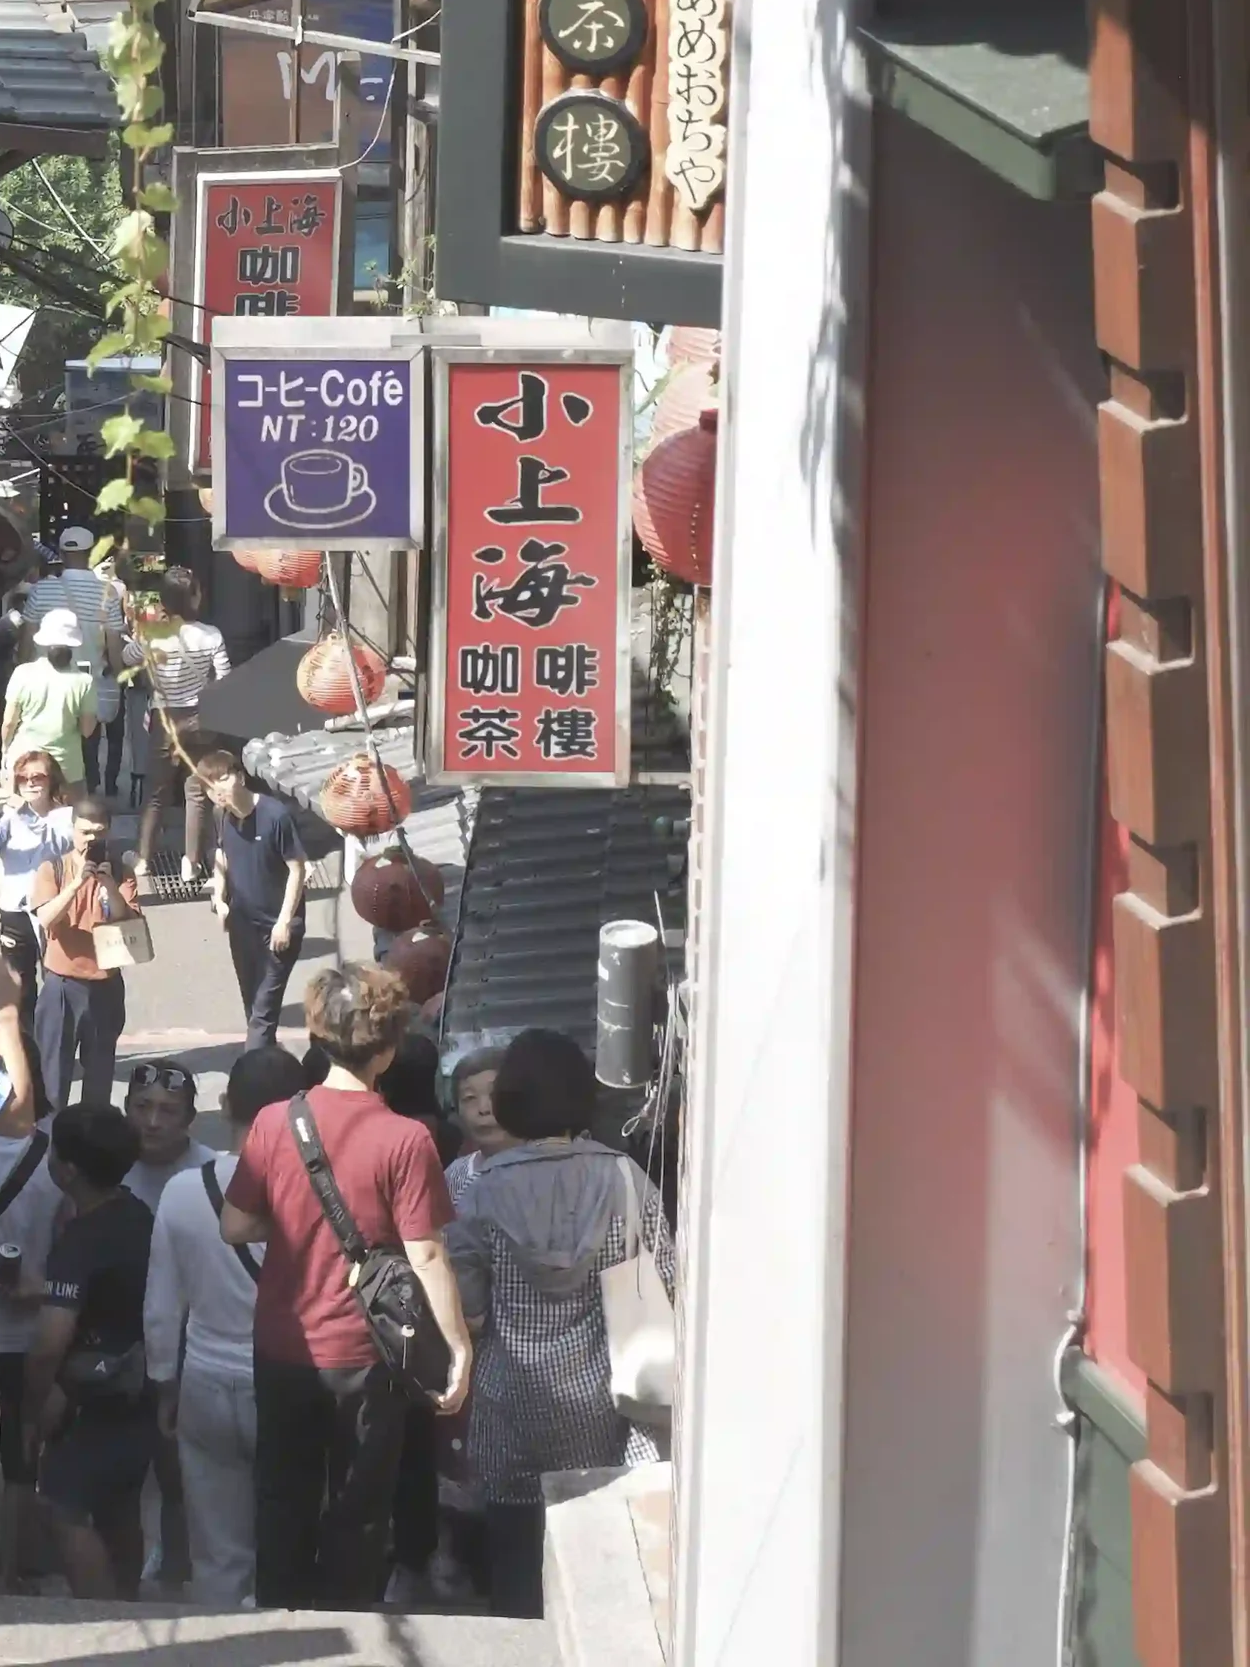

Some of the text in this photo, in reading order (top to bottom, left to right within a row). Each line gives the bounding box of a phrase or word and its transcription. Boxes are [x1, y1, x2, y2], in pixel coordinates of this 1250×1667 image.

[216, 193, 327, 239] 小上海
[471, 370, 599, 630] 小上海
[458, 641, 599, 696] 咖啡
[457, 705, 599, 761] 茶樓
